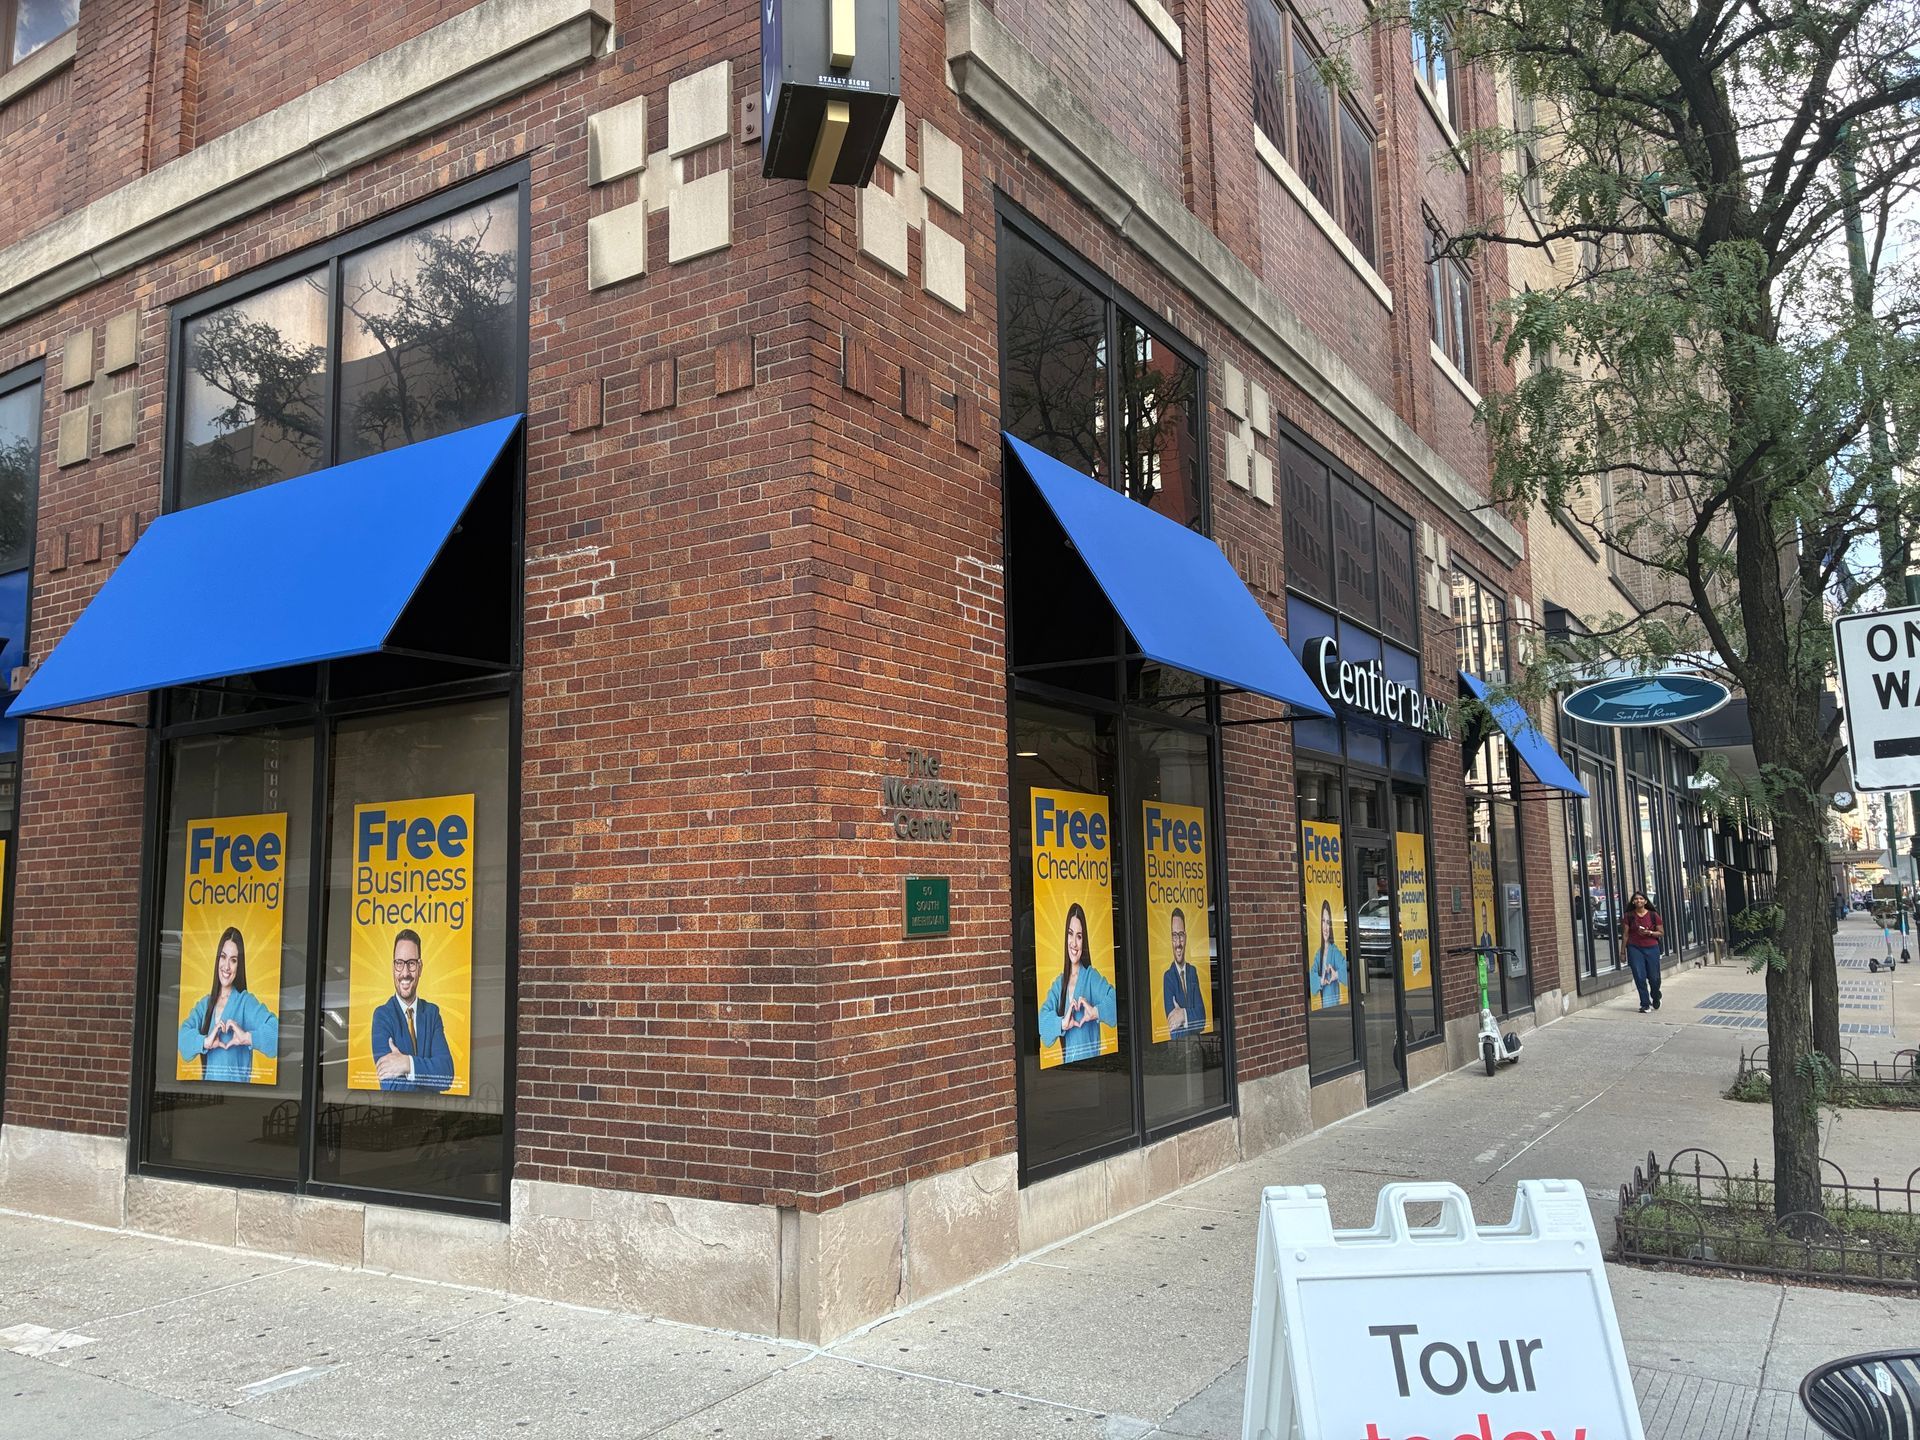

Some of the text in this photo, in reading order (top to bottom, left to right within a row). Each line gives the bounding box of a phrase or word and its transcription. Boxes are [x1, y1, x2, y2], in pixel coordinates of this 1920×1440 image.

[818, 75, 847, 85] STALEY
[848, 78, 870, 87] SIGNS
[1320, 636, 1452, 740] Centier BANK
[1872, 669, 1920, 710] W
[1613, 708, 1677, 720] Seafood Room
[906, 748, 940, 777] The
[884, 777, 960, 810] Meridian
[359, 810, 467, 862] Free
[894, 811, 953, 840] Centre
[1035, 796, 1107, 850] Free
[1146, 807, 1203, 854] Free
[190, 827, 281, 874] Free
[1304, 826, 1340, 864] Free
[1408, 850, 1415, 864] A
[1471, 844, 1491, 870] Free
[357, 861, 467, 895] Business
[1147, 853, 1204, 880] Business
[1399, 866, 1425, 888] perfect
[922, 886, 932, 896] 50
[1401, 889, 1426, 905] account
[916, 900, 940, 911] SOUTH
[1410, 906, 1419, 923] for
[911, 915, 944, 927] MERIDIAN
[1403, 927, 1428, 944] everyone
[1368, 1324, 1543, 1397] Tour
